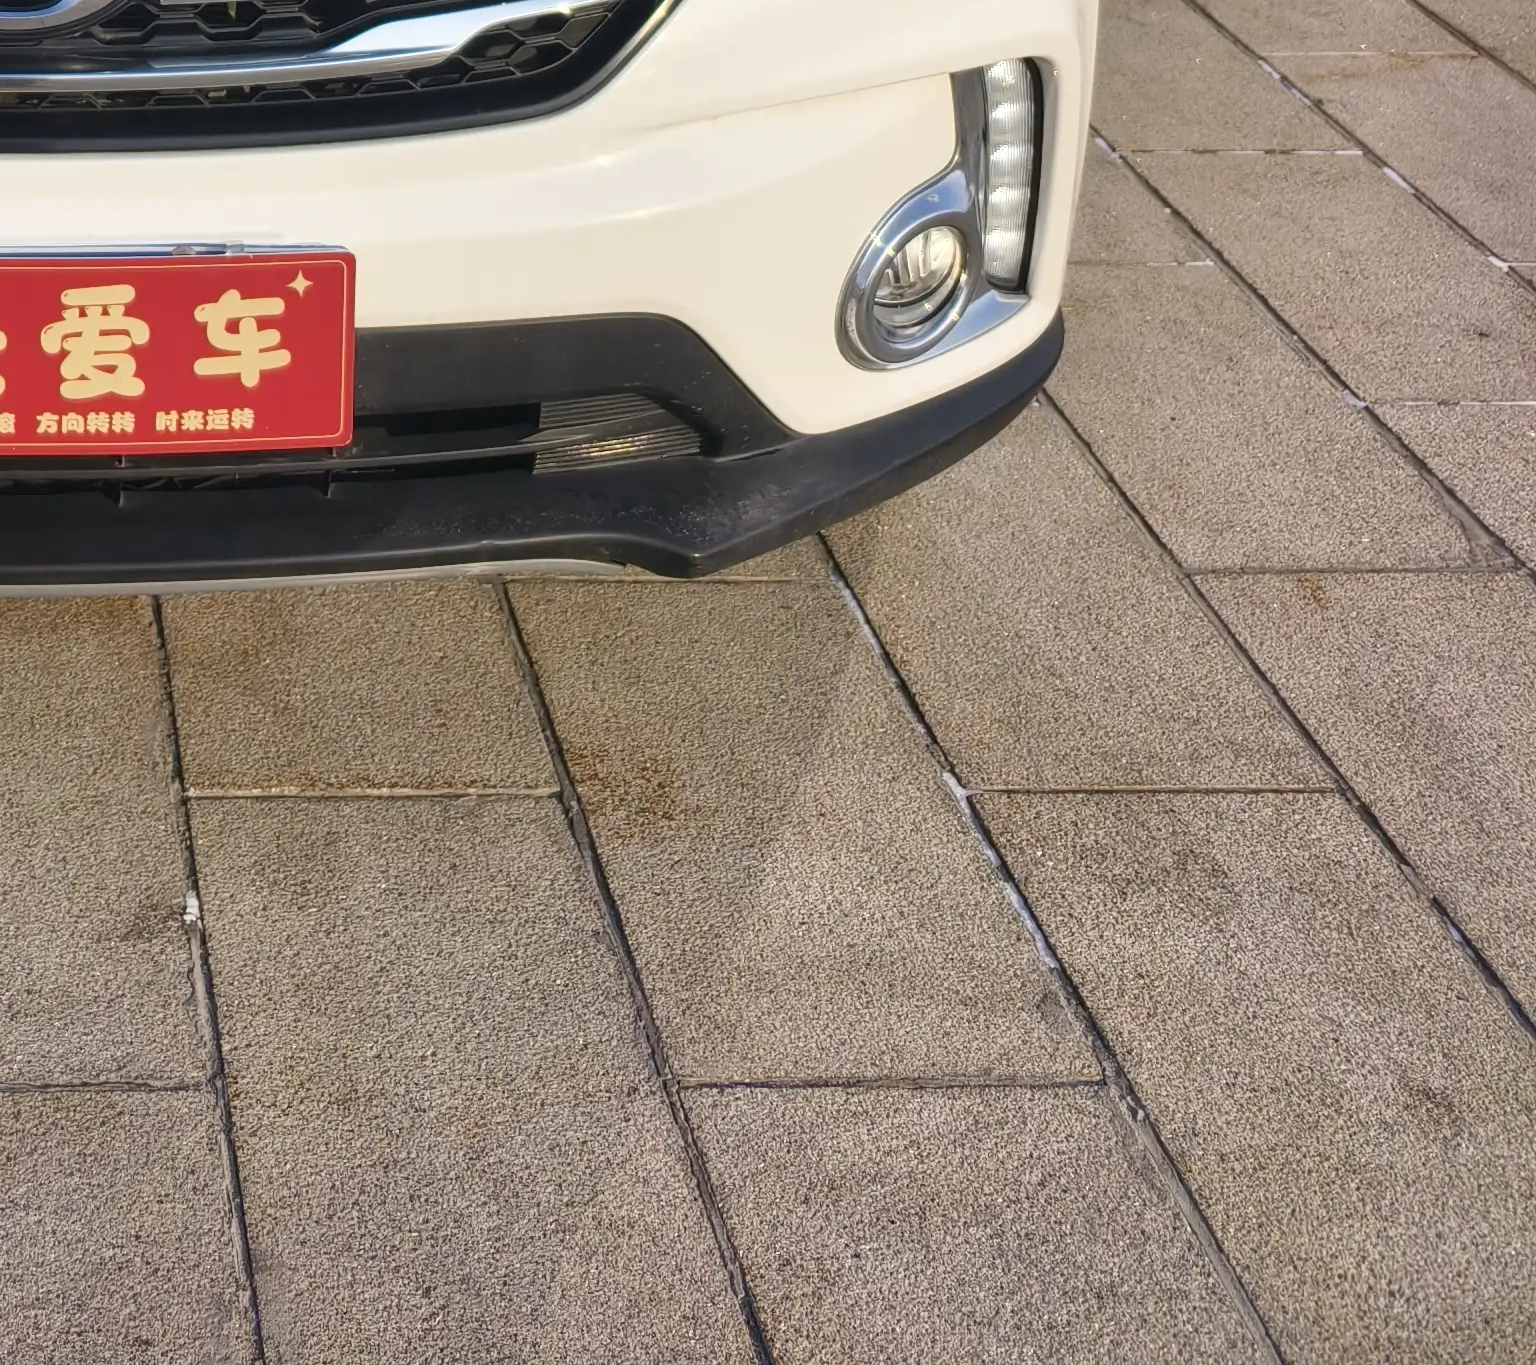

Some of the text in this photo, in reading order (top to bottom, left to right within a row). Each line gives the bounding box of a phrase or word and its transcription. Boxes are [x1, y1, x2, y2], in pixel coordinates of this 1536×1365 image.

[36, 412, 135, 434] 方向转转
[155, 408, 255, 432] 时来运转
